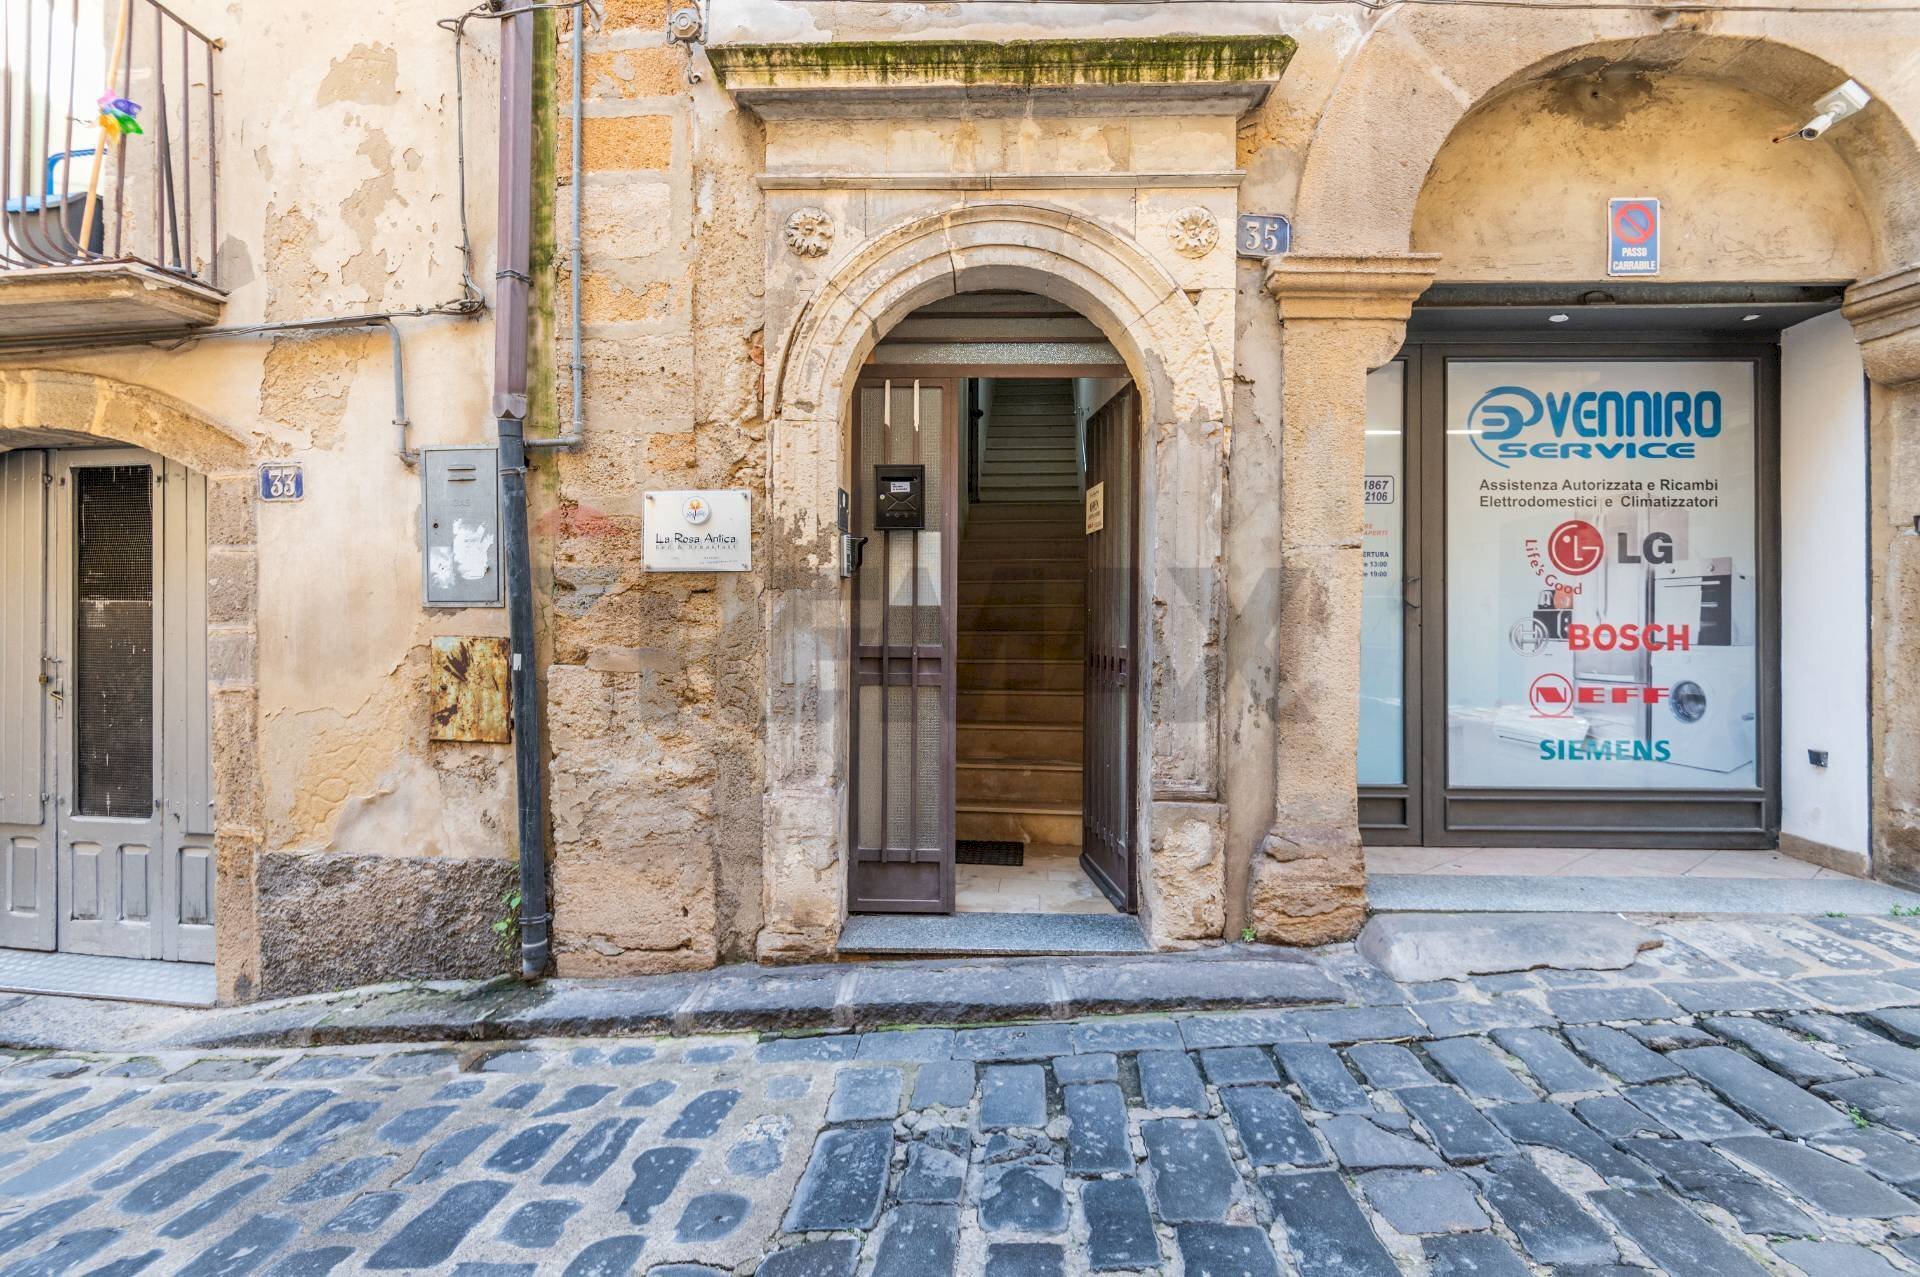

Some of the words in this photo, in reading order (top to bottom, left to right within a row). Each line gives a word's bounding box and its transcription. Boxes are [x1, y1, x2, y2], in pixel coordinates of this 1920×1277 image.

[1245, 221, 1279, 251] 35
[1621, 247, 1648, 257] PASSO
[1612, 260, 1657, 271] CARRABILE
[1545, 390, 1722, 438] VENNIRO
[1498, 442, 1696, 459] SERVICE
[269, 469, 297, 497] 33
[1479, 479, 1558, 491] Assistenza
[1562, 479, 1643, 491] Autorizzata
[1647, 482, 1655, 491] e
[1660, 479, 1718, 491] Ricambi
[1364, 491, 1388, 501] 2106
[1479, 495, 1597, 508] Elettrodomestici
[1605, 498, 1613, 508] e
[1620, 495, 1718, 508] Climatizzatori
[655, 532, 670, 544] La
[674, 532, 700, 544] Rosa
[703, 532, 736, 544] Antica
[1617, 531, 1673, 565] LG
[1525, 539, 1545, 577] Life's
[1545, 574, 1583, 596] Good
[1568, 623, 1690, 652] BOSCH
[1536, 686, 1670, 704] NEFF
[1539, 739, 1671, 761] SIEMENS
